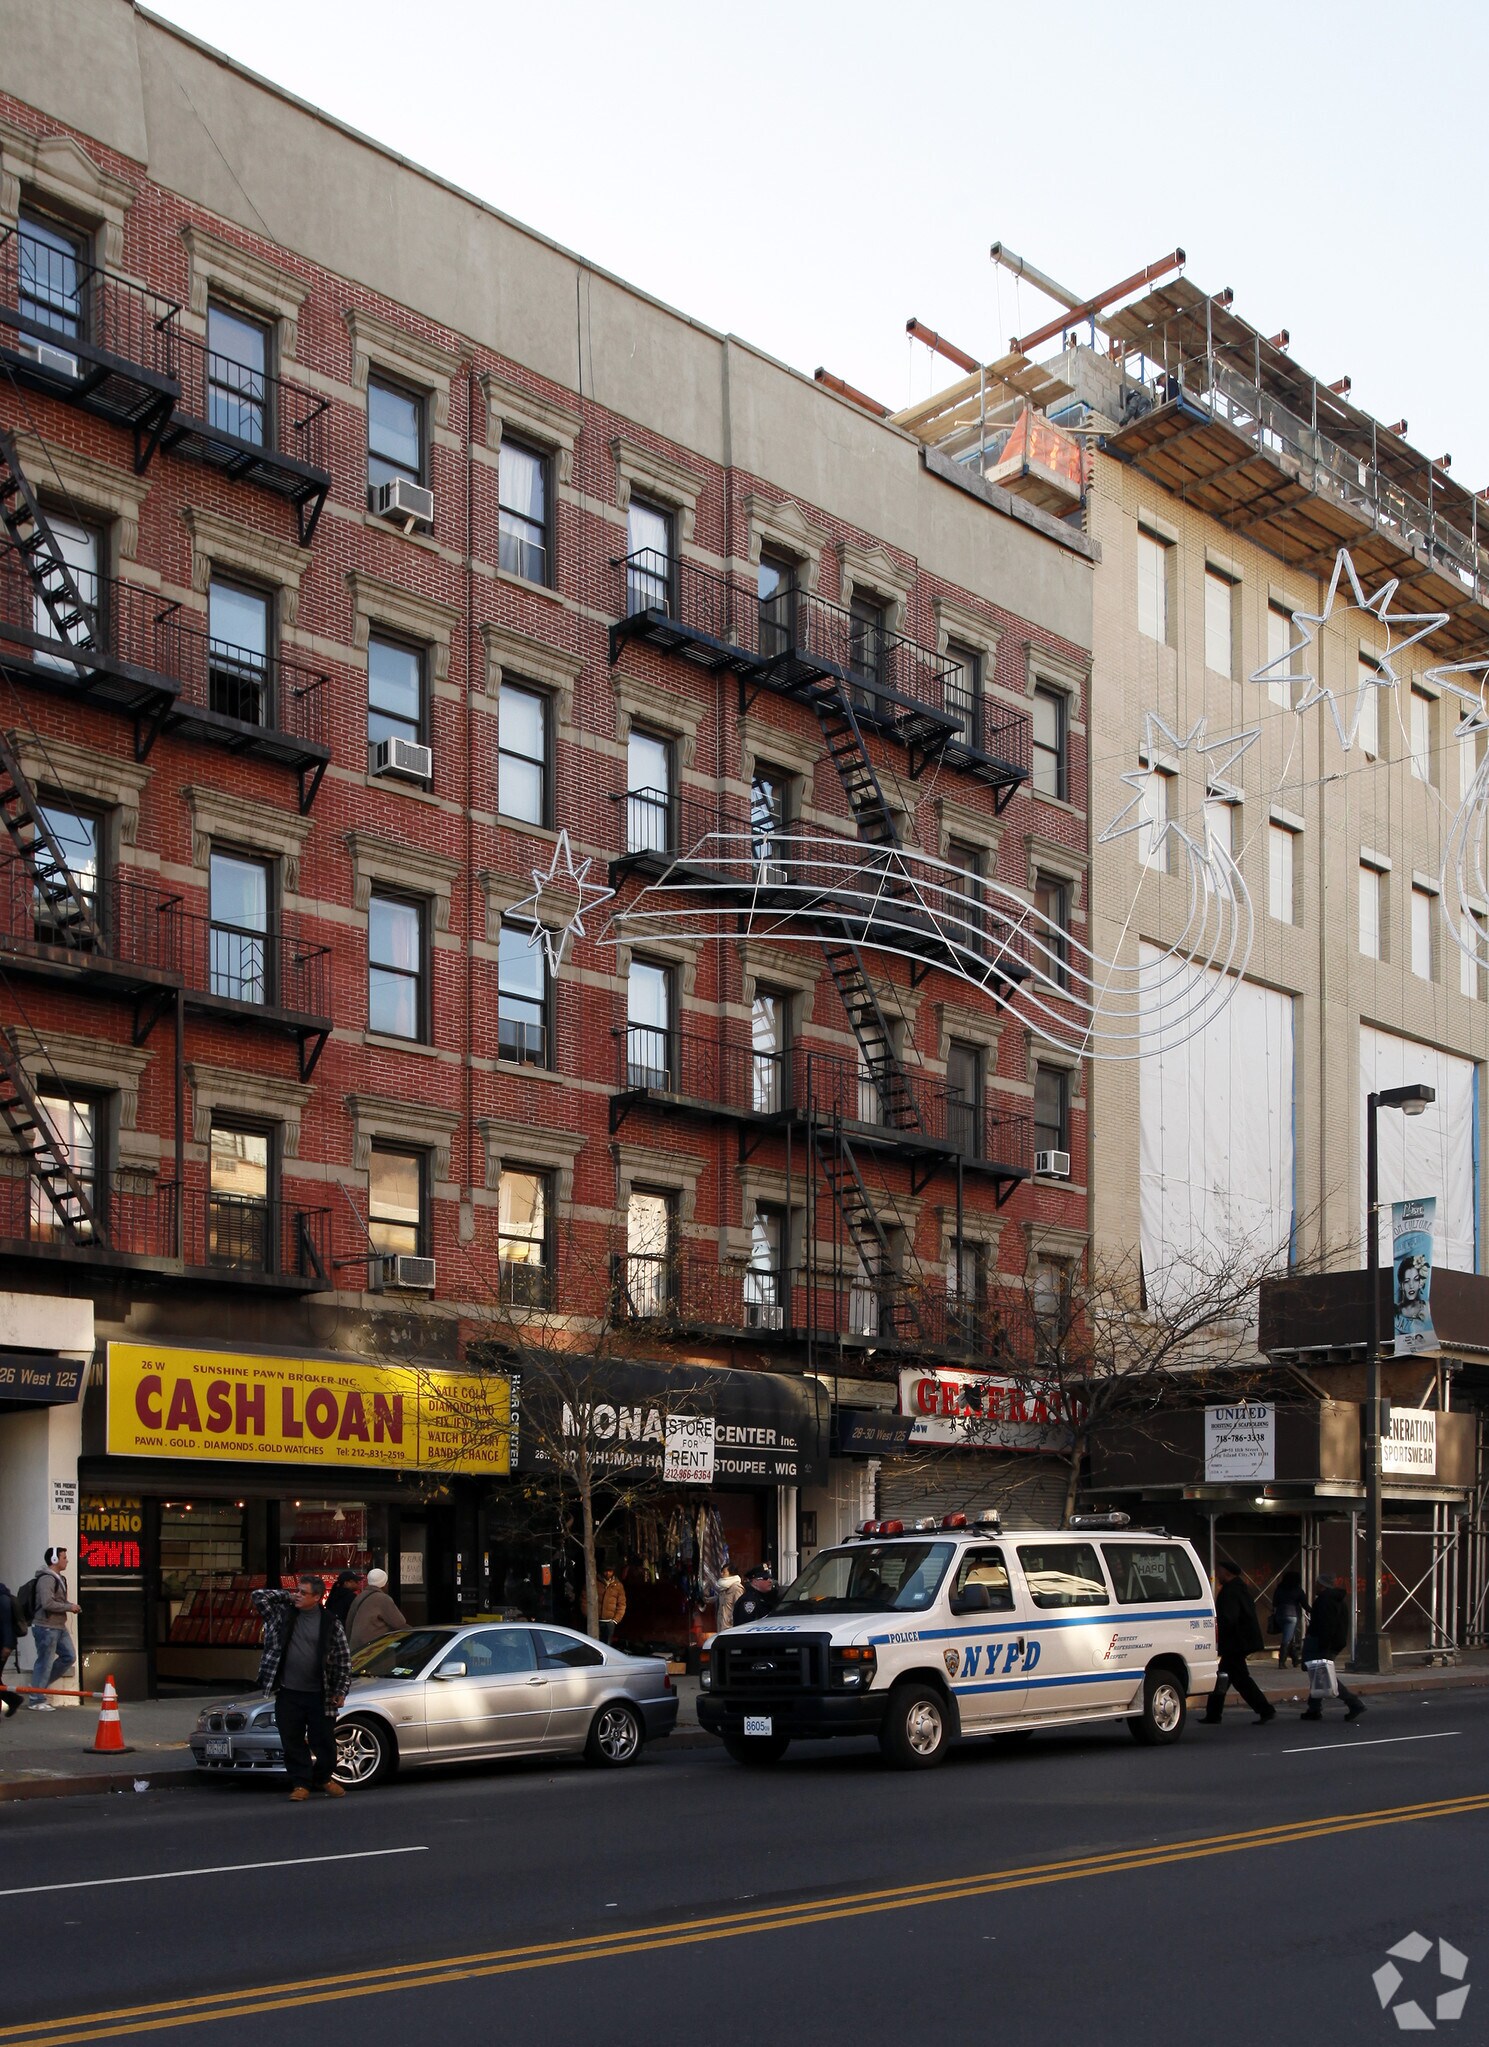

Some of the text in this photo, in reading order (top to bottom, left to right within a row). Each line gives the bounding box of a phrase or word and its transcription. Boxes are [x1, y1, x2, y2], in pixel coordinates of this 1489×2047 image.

[142, 1361, 165, 1370] 26 W
[0, 1368, 16, 1383] 26
[21, 1369, 52, 1385] West
[55, 1372, 78, 1387] 125
[193, 1365, 360, 1386] SUNSHINE PAWN BROKER INC.
[437, 1385, 486, 1400] SALE GOLD
[511, 1375, 521, 1408] HAIR
[135, 1374, 403, 1444] CASH LOAN
[428, 1400, 472, 1414] DIAMOND
[1215, 1407, 1267, 1420] UNITED
[435, 1416, 449, 1427] FIX
[669, 1418, 713, 1437] STORE
[428, 1431, 458, 1444] WATCH
[715, 1424, 797, 1447] CENTER Inc.
[852, 1427, 907, 1442] 28-30 West 125
[1381, 1417, 1435, 1443] ENERATION
[135, 1436, 163, 1446] PAWN
[170, 1438, 195, 1448] GOLD
[204, 1440, 254, 1451] DIAMONDS
[284, 1445, 324, 1455] WATCHES
[682, 1439, 699, 1448] FOR
[1216, 1434, 1265, 1443] 718-786-3338
[336, 1447, 350, 1456] Tel:
[428, 1447, 499, 1461] BANDS CHANGE
[671, 1450, 709, 1467] RENT
[1383, 1445, 1433, 1464] SPORTSWEAR
[595, 1451, 642, 1467] HUMAN
[645, 1454, 664, 1468] HA
[665, 1468, 711, 1480] 212-966-6364
[775, 1463, 797, 1475] WIG
[890, 1632, 918, 1643] POLICE
[960, 1641, 1041, 1678] NYPD
[746, 1721, 765, 1731] 8605
